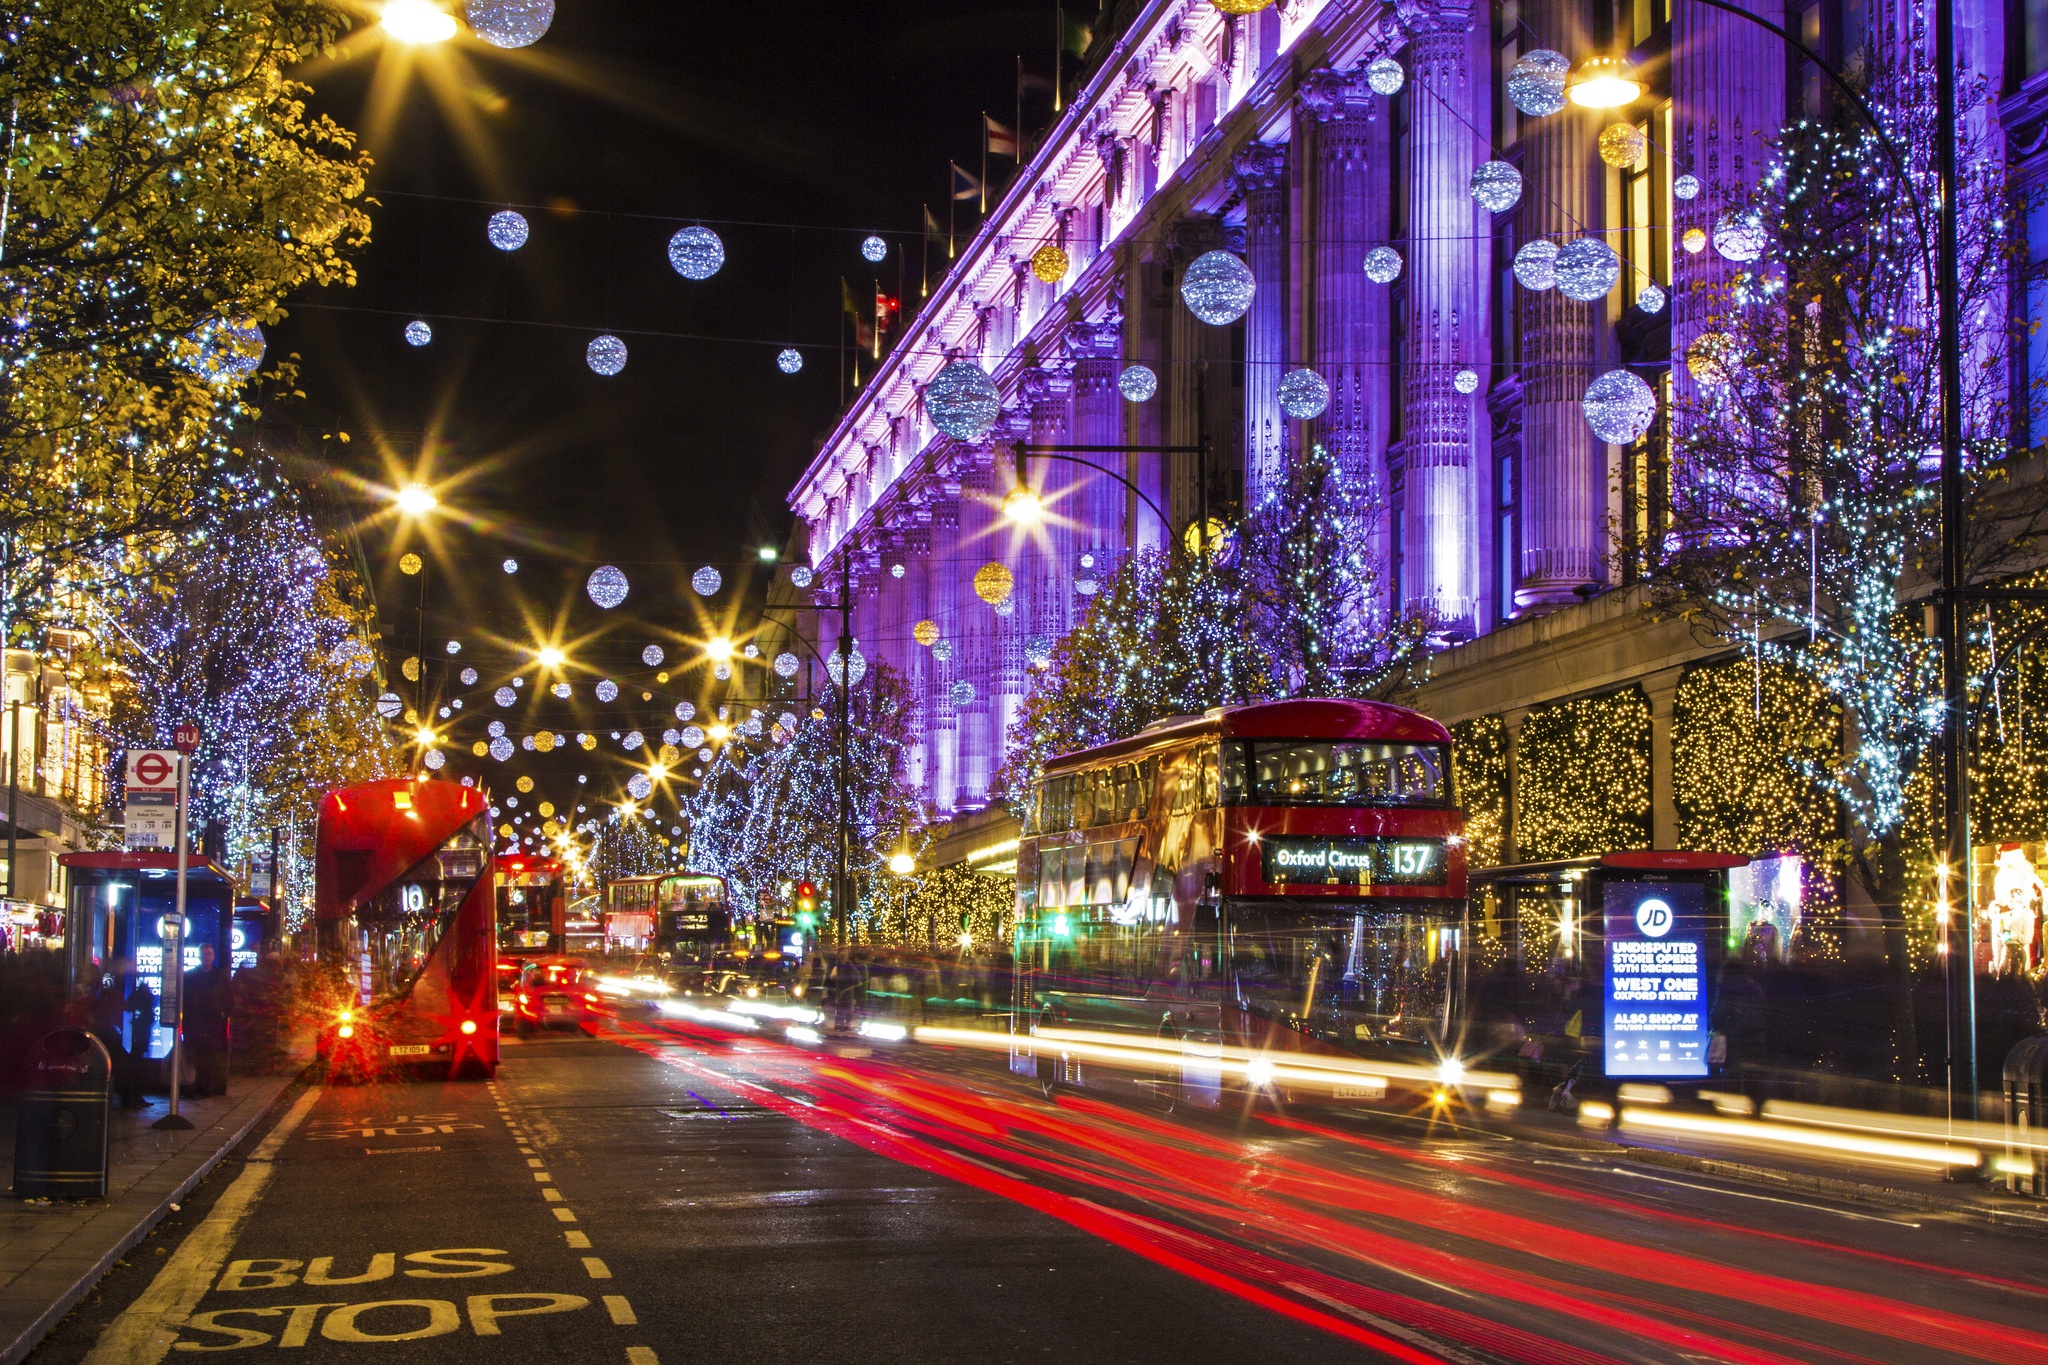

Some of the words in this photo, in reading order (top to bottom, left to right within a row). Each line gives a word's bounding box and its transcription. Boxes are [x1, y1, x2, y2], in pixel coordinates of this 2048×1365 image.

[1278, 849, 1325, 867] Oxford
[1328, 850, 1370, 867] Circus
[1394, 846, 1430, 874] 137
[402, 885, 424, 912] 10
[513, 890, 524, 903] 6
[698, 914, 708, 922] 23
[1642, 909, 1667, 926] JD
[1612, 942, 1698, 954] UNDISPUTED
[1612, 953, 1655, 964] STORE
[1655, 953, 1698, 964] OPENS
[1613, 964, 1640, 973] 10TH
[1640, 964, 1698, 973] DECEMBER
[1612, 977, 1662, 992] WEST
[1663, 977, 1698, 992] ONE
[1613, 991, 1658, 1001] OXFORD
[1658, 991, 1698, 1001] STREET
[1614, 1013, 1648, 1024] ALSO
[1648, 1013, 1682, 1024] SHOP
[1683, 1013, 1698, 1024] AT
[304, 1123, 485, 1141] STOP
[216, 1248, 515, 1291] BUS
[171, 1293, 589, 1352] STOP
